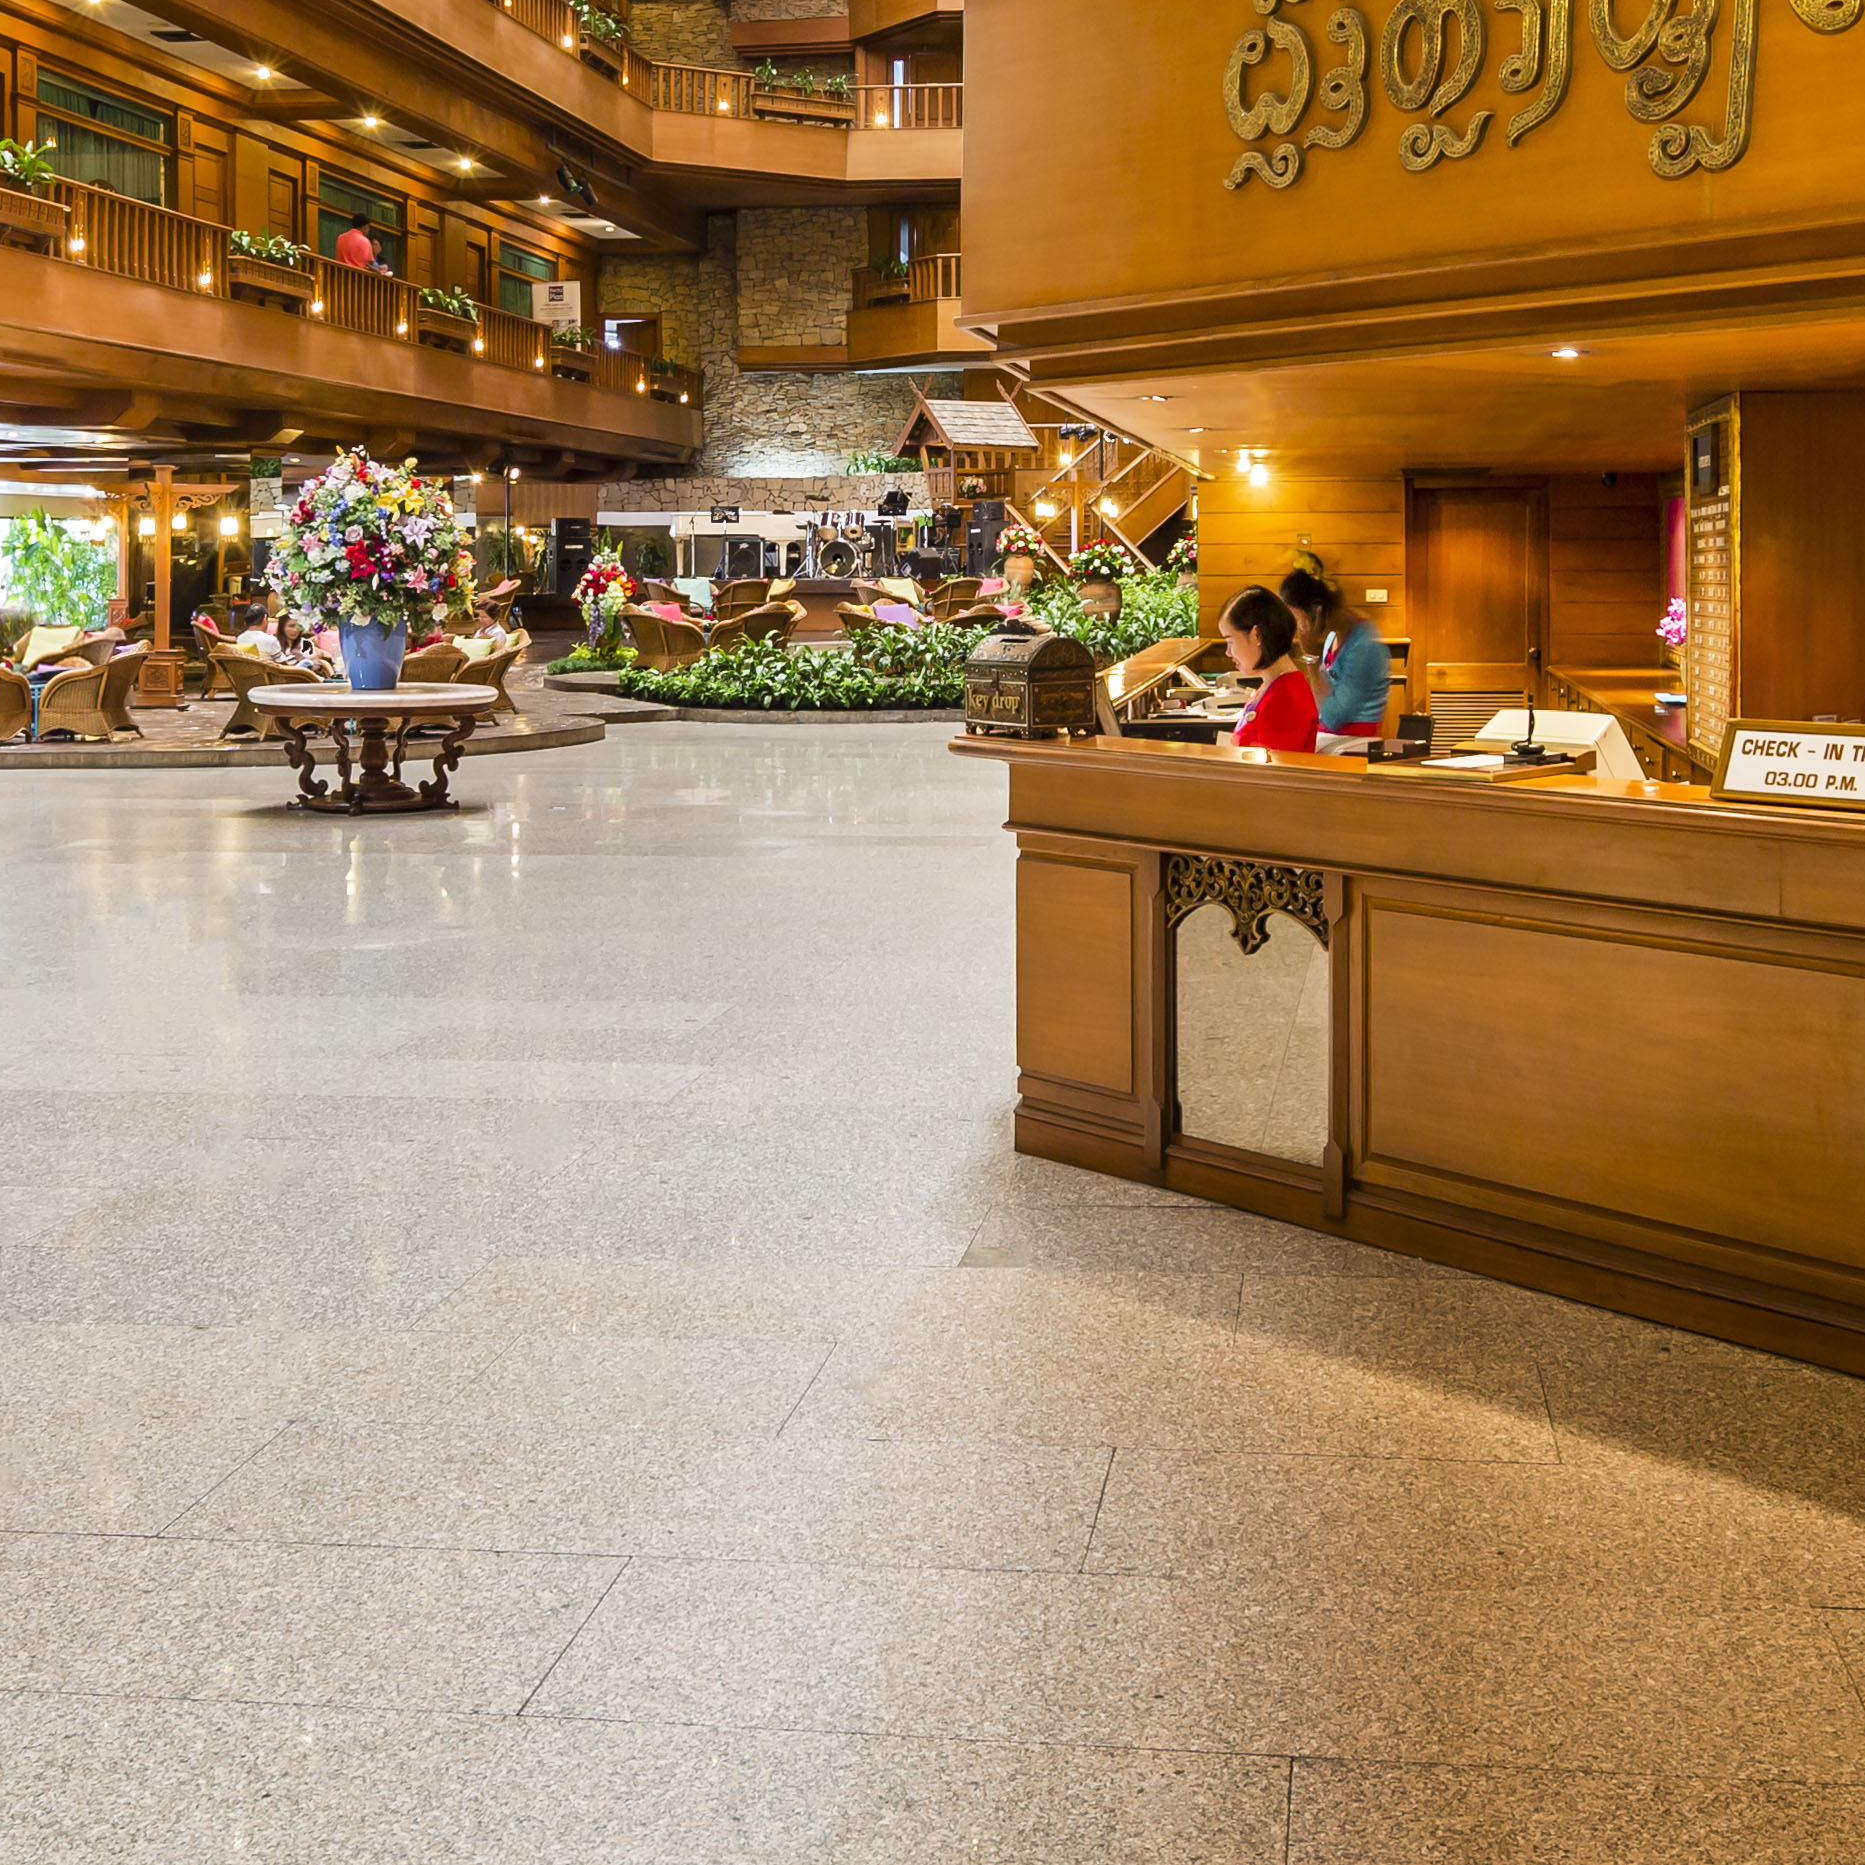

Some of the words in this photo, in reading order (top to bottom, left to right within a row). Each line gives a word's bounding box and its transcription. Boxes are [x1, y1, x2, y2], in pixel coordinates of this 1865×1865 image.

[968, 689, 990, 713] key
[992, 691, 1020, 714] drop
[1741, 739, 1801, 759] CHECK
[1823, 743, 1845, 761] IN
[1764, 771, 1819, 789] 03.00
[1825, 775, 1858, 792] P.M.
